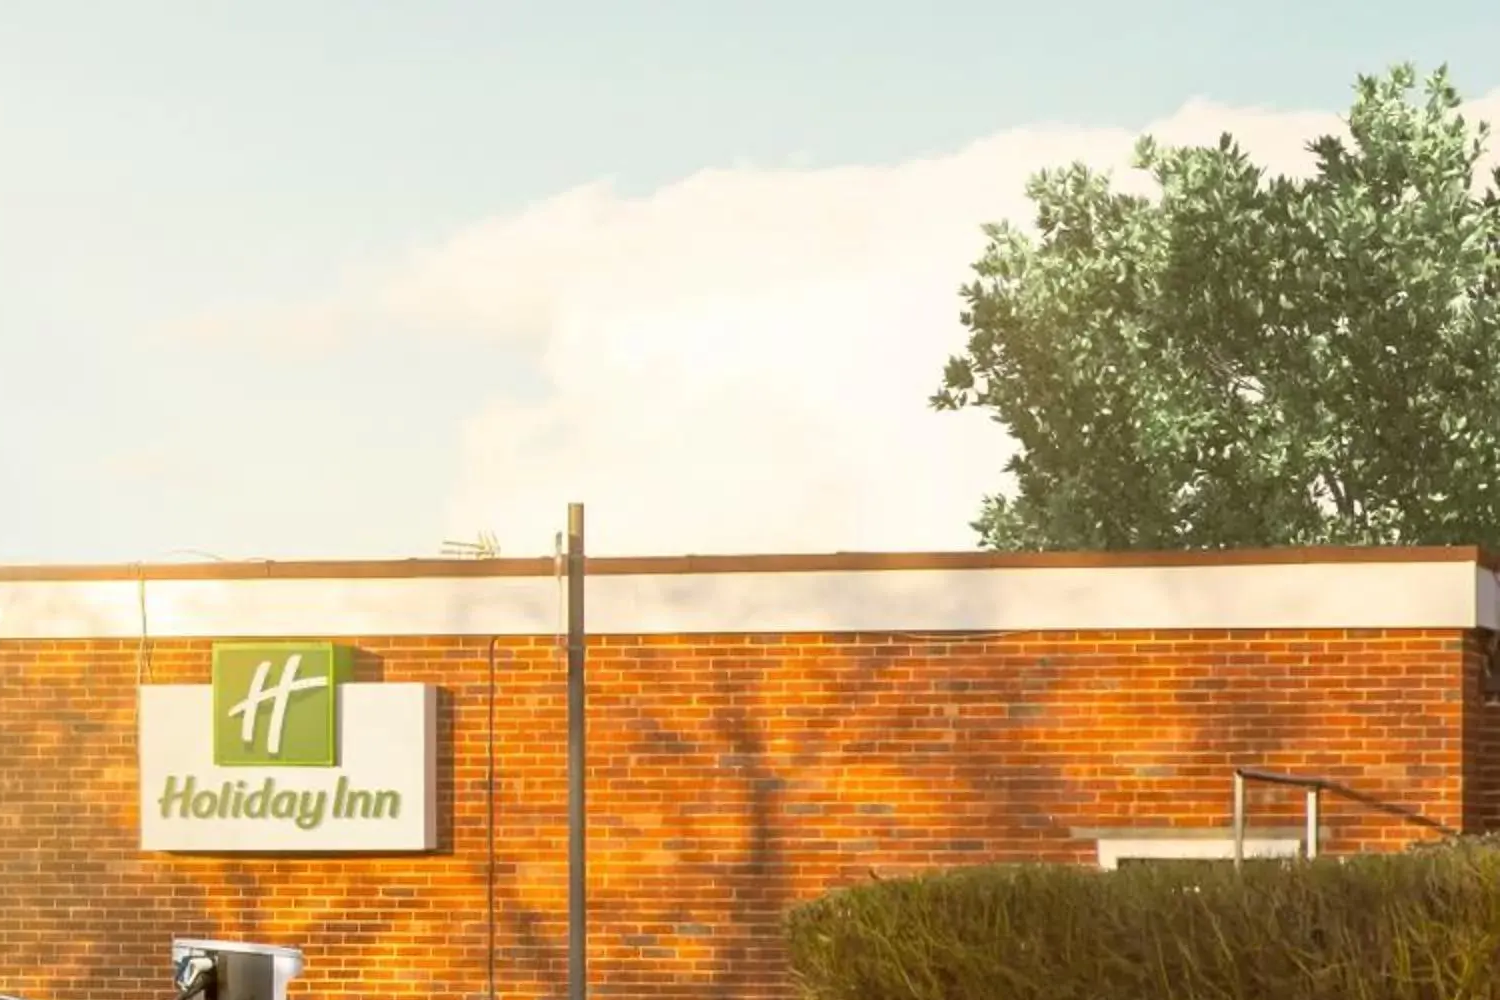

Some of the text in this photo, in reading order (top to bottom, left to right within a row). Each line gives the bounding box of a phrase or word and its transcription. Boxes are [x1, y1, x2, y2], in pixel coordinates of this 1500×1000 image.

[228, 654, 328, 754] H
[158, 775, 401, 829] Holiday Inn
